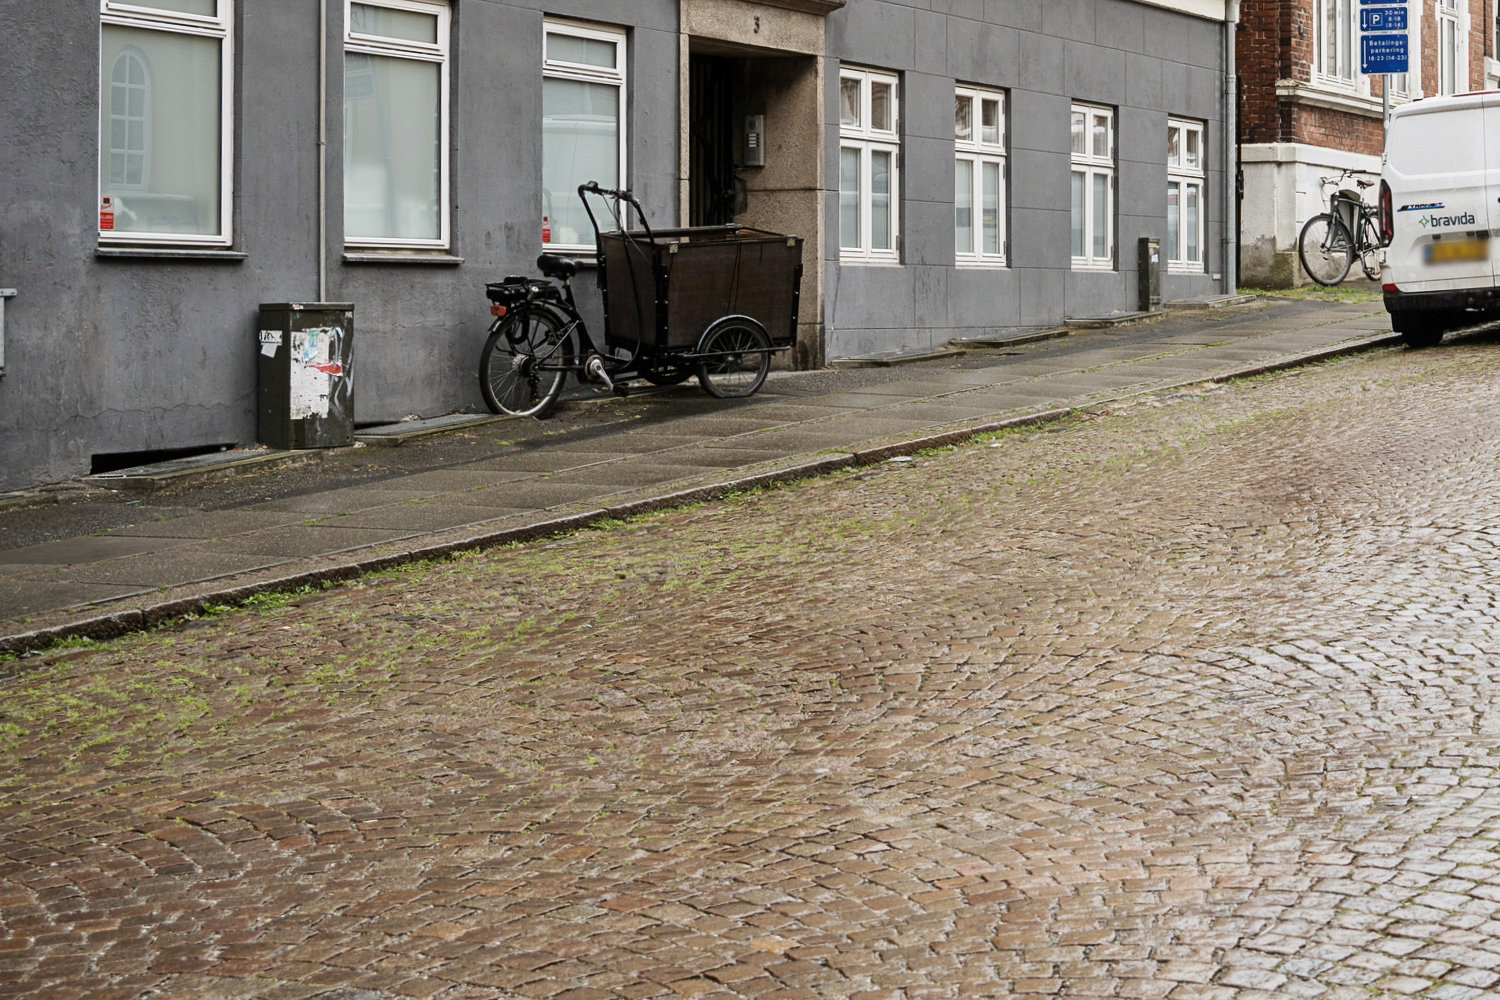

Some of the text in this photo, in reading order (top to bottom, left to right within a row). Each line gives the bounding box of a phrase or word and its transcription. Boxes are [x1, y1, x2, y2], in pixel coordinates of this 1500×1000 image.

[753, 15, 760, 34] 3
[1370, 47, 1404, 55] parkering
[1430, 211, 1475, 228] bravida
